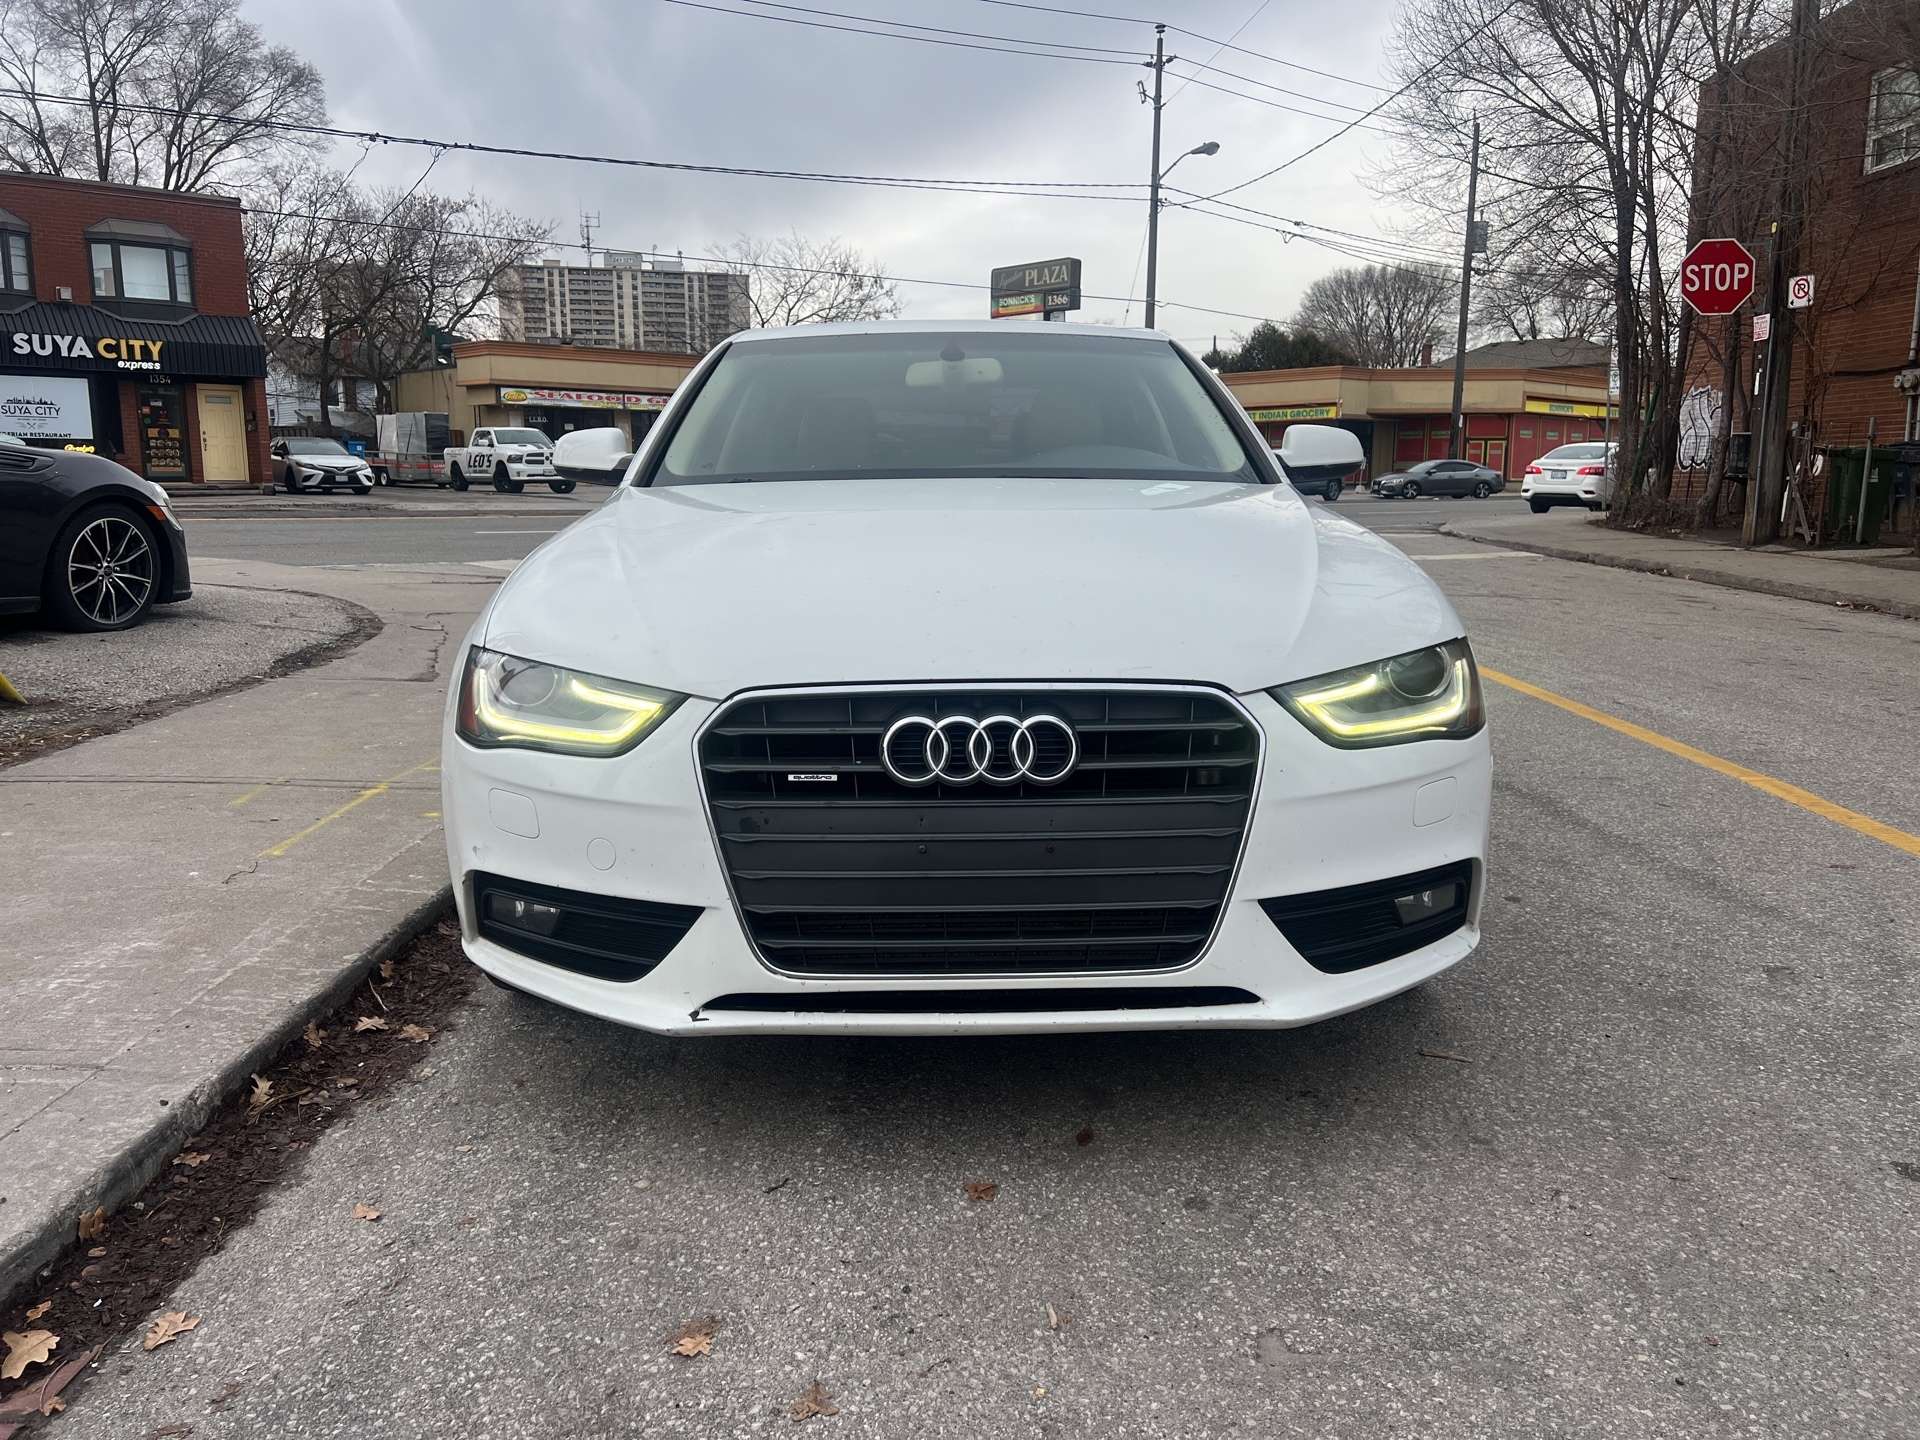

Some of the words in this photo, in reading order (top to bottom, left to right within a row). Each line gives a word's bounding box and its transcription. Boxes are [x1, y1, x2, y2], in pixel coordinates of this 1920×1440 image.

[1025, 265, 1068, 287] PLAZA
[1685, 263, 1749, 292] STOP
[1047, 294, 1068, 306] 1366
[12, 332, 94, 359] SUYA
[97, 338, 163, 361] CITY
[118, 360, 161, 371] express
[149, 374, 171, 385] 1354
[534, 390, 641, 404] SEAFOOD
[1, 405, 31, 416] SUYA
[35, 406, 61, 416] CITY
[1258, 410, 1288, 419] INDIAN
[1289, 408, 1331, 418] GROCERY
[467, 454, 493, 468] LEO'S
